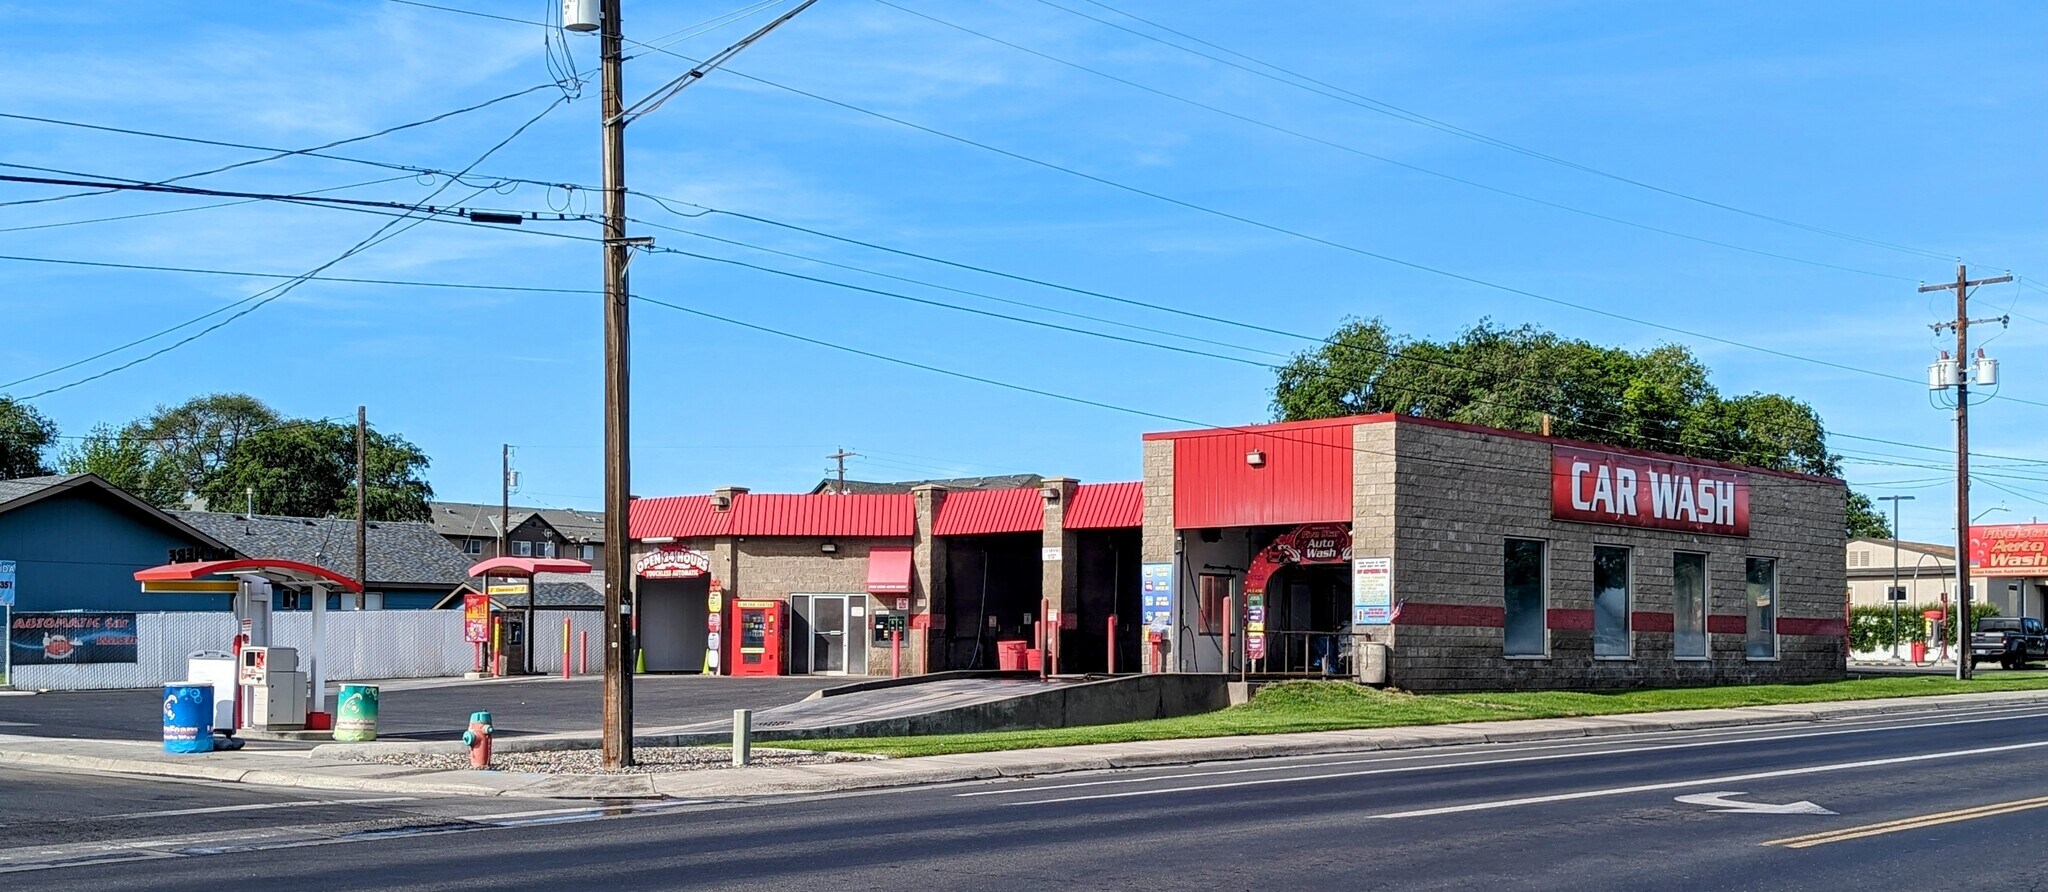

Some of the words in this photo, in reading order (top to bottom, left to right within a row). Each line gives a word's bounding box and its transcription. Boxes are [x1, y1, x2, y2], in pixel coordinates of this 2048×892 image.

[1571, 461, 1637, 516] CAR
[1650, 471, 1735, 526] WASH
[1307, 538, 1335, 549] Auto
[1991, 539, 2045, 553] Auto
[1306, 547, 1337, 559] Wash
[1990, 552, 2048, 567] Wash
[636, 551, 662, 574] OPEN
[663, 550, 676, 563] 24
[677, 549, 709, 573] HOURS
[645, 568, 672, 578] TOUCHLESS
[672, 568, 699, 577] AUTOMATIC
[12, 617, 101, 629] AUTOMATIC
